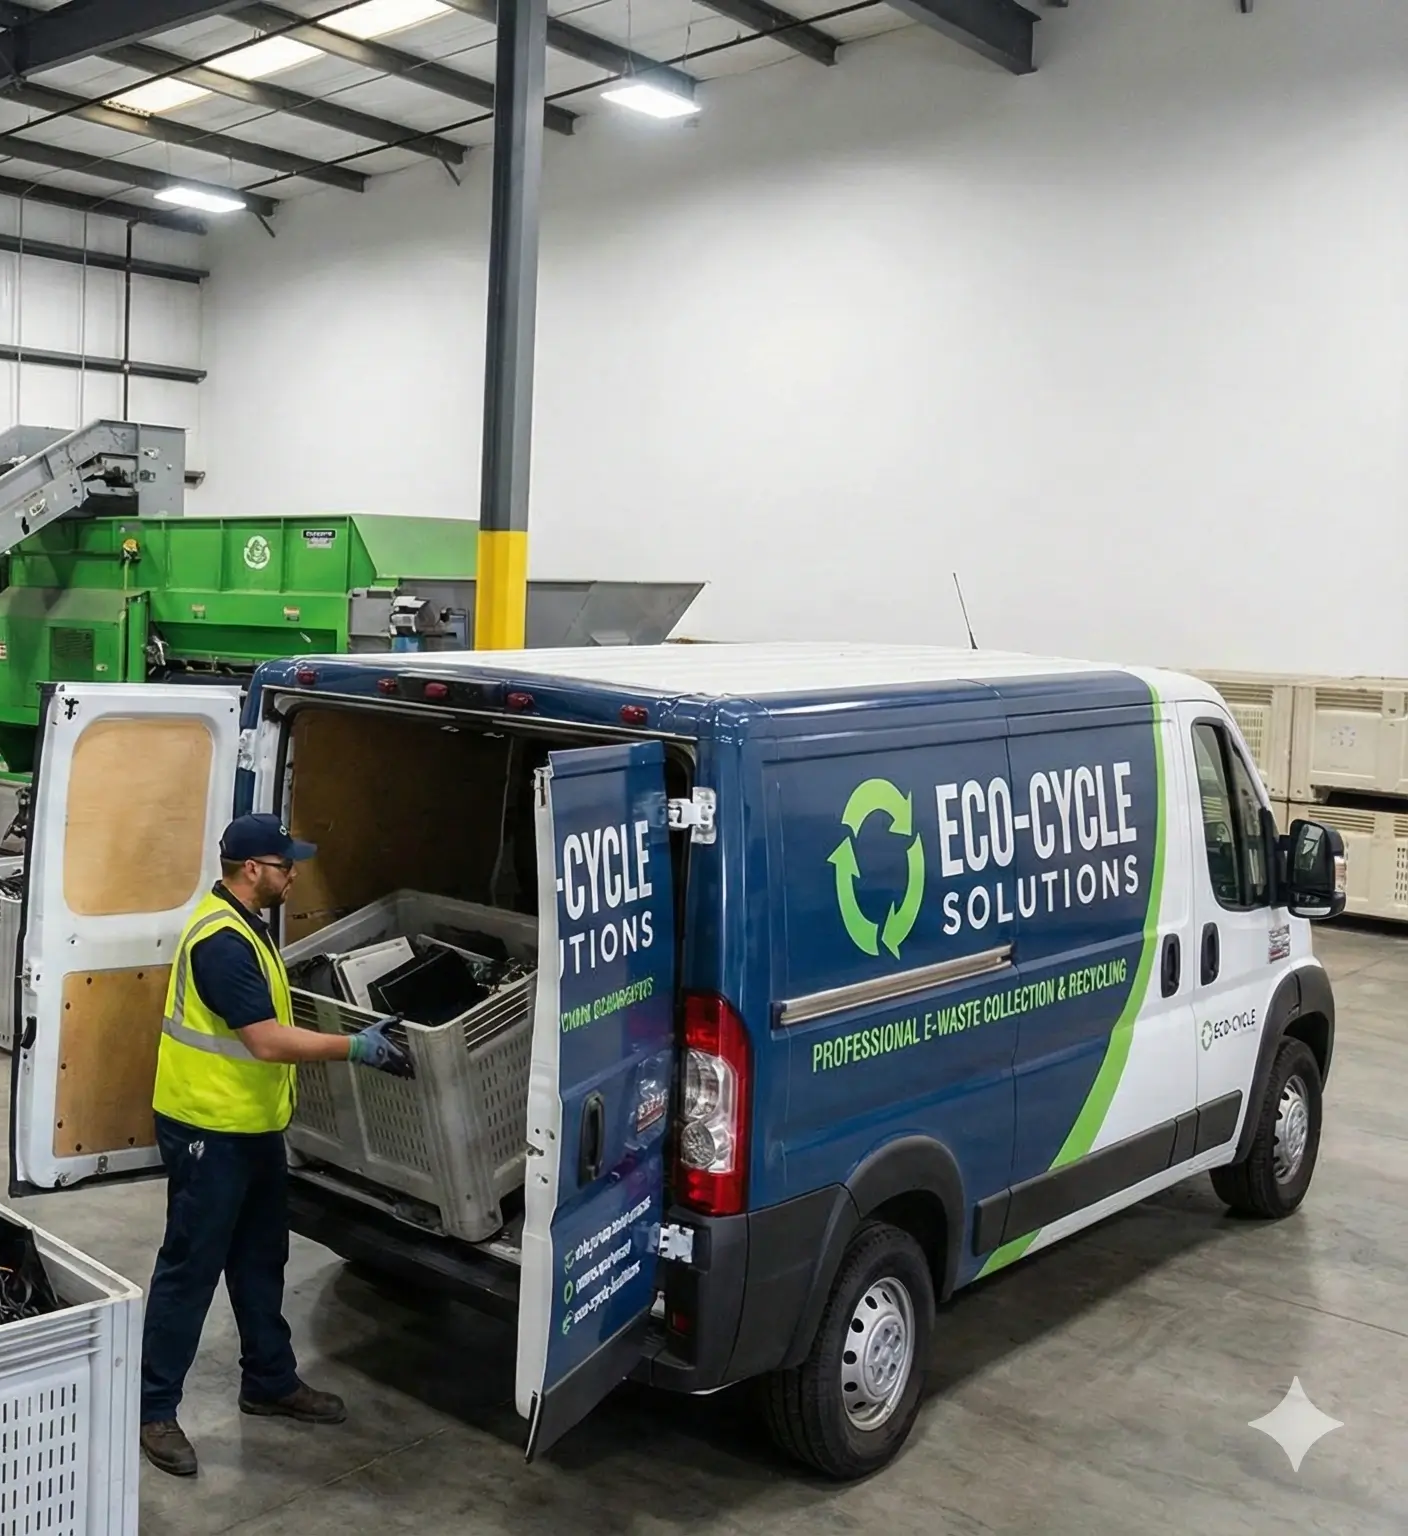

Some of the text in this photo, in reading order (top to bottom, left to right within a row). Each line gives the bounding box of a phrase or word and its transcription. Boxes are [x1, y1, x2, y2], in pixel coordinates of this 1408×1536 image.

[935, 761, 1138, 878] ECO-CYCLE
[942, 854, 1140, 936] SOLUTIONS
[812, 957, 1127, 1073] PROFESSIONAL E-WASTE COLLECTION & RECYCLING
